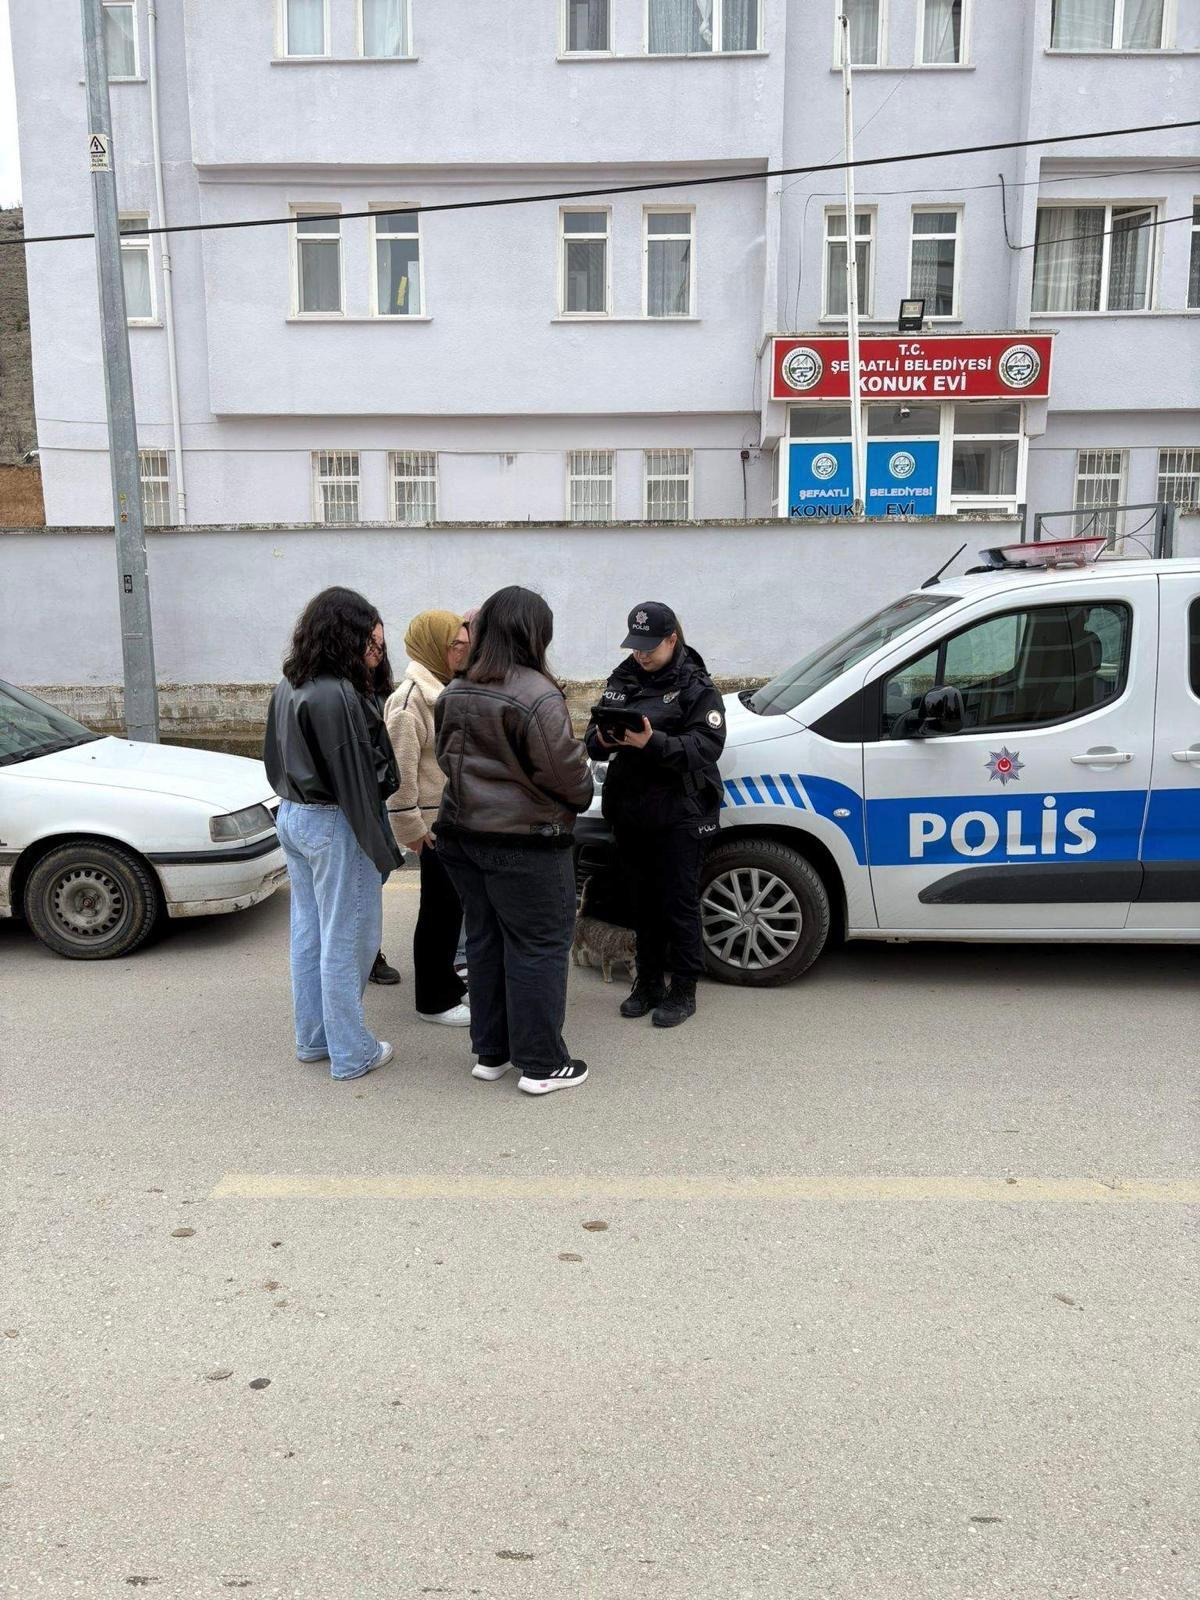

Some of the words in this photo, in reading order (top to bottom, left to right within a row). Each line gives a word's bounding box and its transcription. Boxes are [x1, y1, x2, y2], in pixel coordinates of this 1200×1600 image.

[899, 344, 925, 355] T.C.
[831, 357, 899, 374] ŞEAATLİ
[904, 356, 992, 371] BELEDİYESİ
[933, 372, 967, 391] EVİ
[799, 487, 849, 500] ŞEFAATLİ
[870, 486, 933, 497] BELEDİYESİ
[791, 504, 854, 517] KONUK
[887, 500, 914, 515] EVİ
[909, 795, 1097, 858] POLİS
